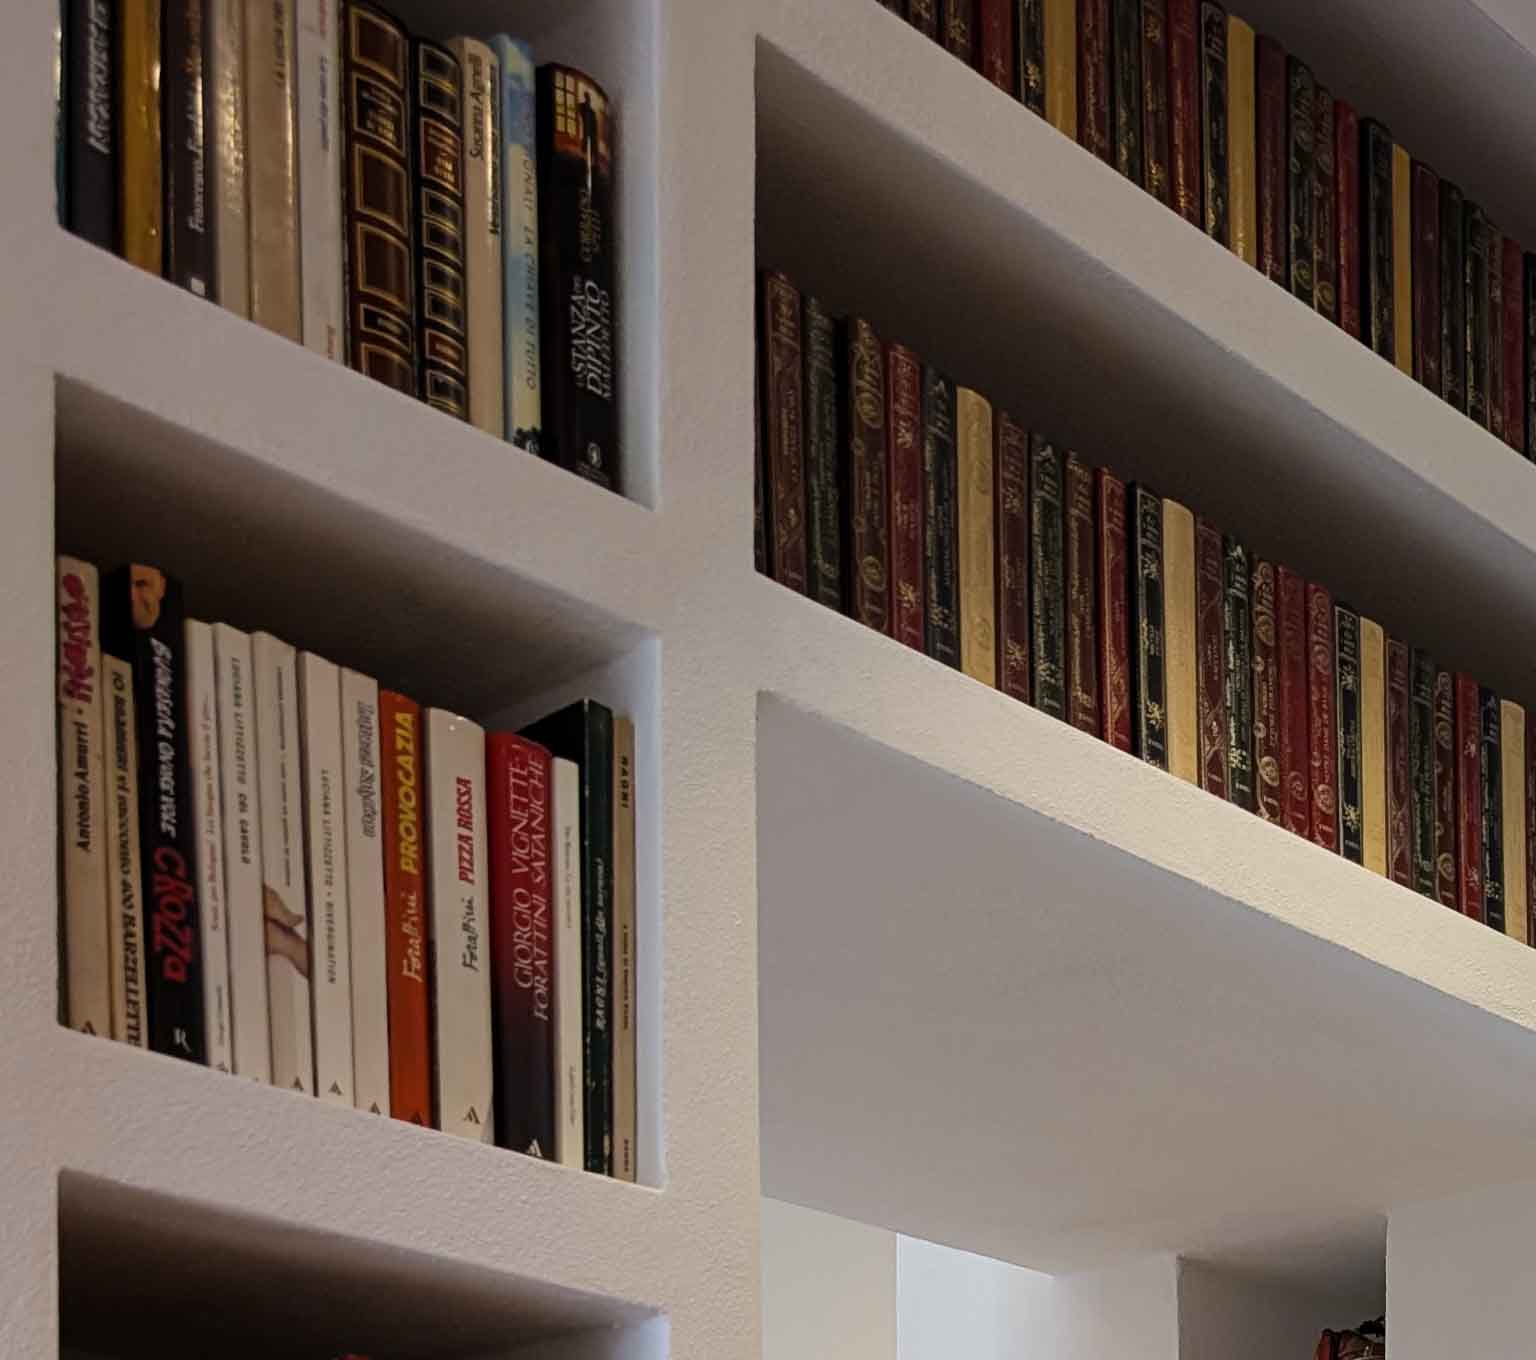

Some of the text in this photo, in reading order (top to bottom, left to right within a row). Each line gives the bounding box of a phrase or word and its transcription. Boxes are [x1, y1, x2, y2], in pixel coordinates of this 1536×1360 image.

[570, 293, 588, 374] STANZA
[585, 279, 602, 396] DIPINTO
[74, 784, 92, 856] Antonio
[395, 711, 419, 877] PROVOCAZIA
[456, 776, 473, 831] ROSSA
[530, 752, 549, 886] SATANICHE
[458, 833, 475, 886] PIZZA
[511, 888, 534, 988] GIORGIO
[532, 894, 549, 1021] FORATTINI
